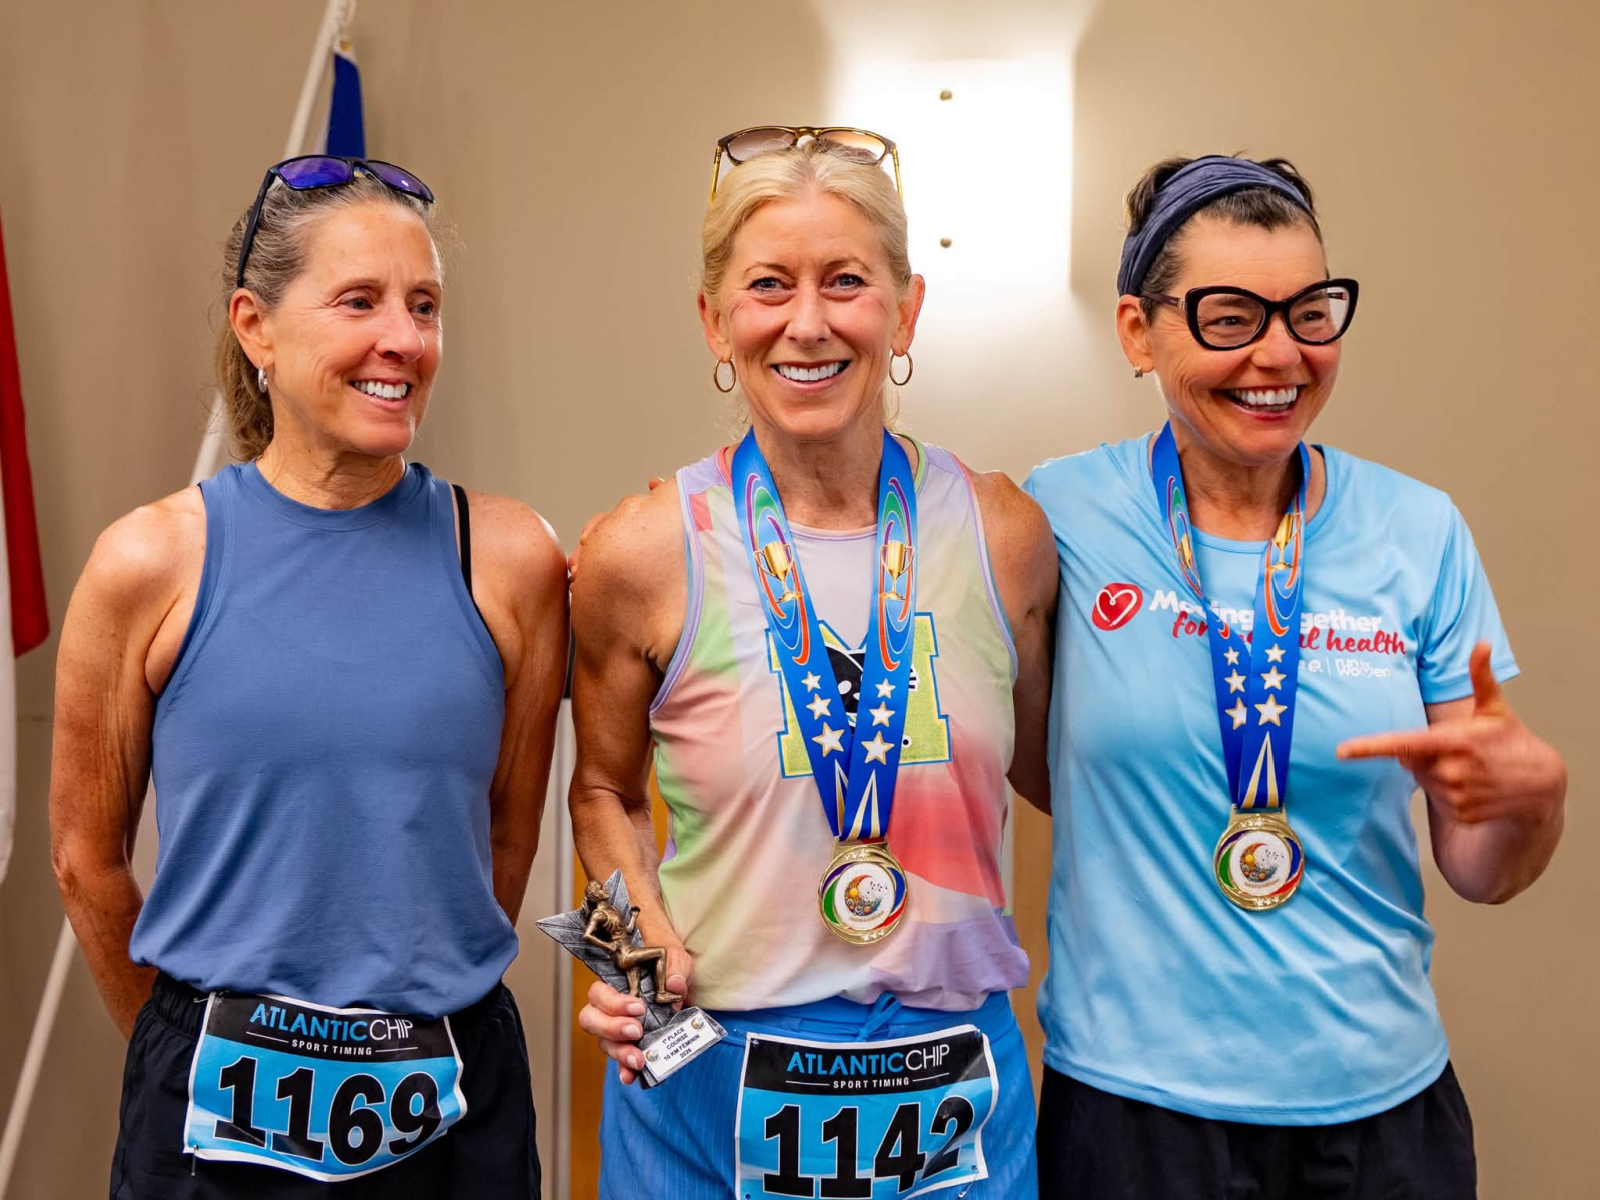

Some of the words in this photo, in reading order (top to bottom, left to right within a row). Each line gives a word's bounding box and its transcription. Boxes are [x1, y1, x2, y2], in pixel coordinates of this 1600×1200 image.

[1172, 610, 1208, 639] for
[1326, 627, 1406, 655] health
[1300, 608, 1382, 634] gether
[250, 1002, 413, 1041] ATLANTICCHIP
[667, 1027, 685, 1041] PLACE
[291, 1038, 329, 1053] SPORT
[332, 1045, 373, 1056] TIMING
[666, 1033, 689, 1050] COURSE
[670, 1048, 680, 1057] KM
[786, 1043, 950, 1076] ATLANTICCHIP
[833, 1079, 868, 1090] SPORT
[872, 1077, 910, 1088] TIMING
[213, 1054, 444, 1167] 1169
[763, 1094, 975, 1199] 1142
